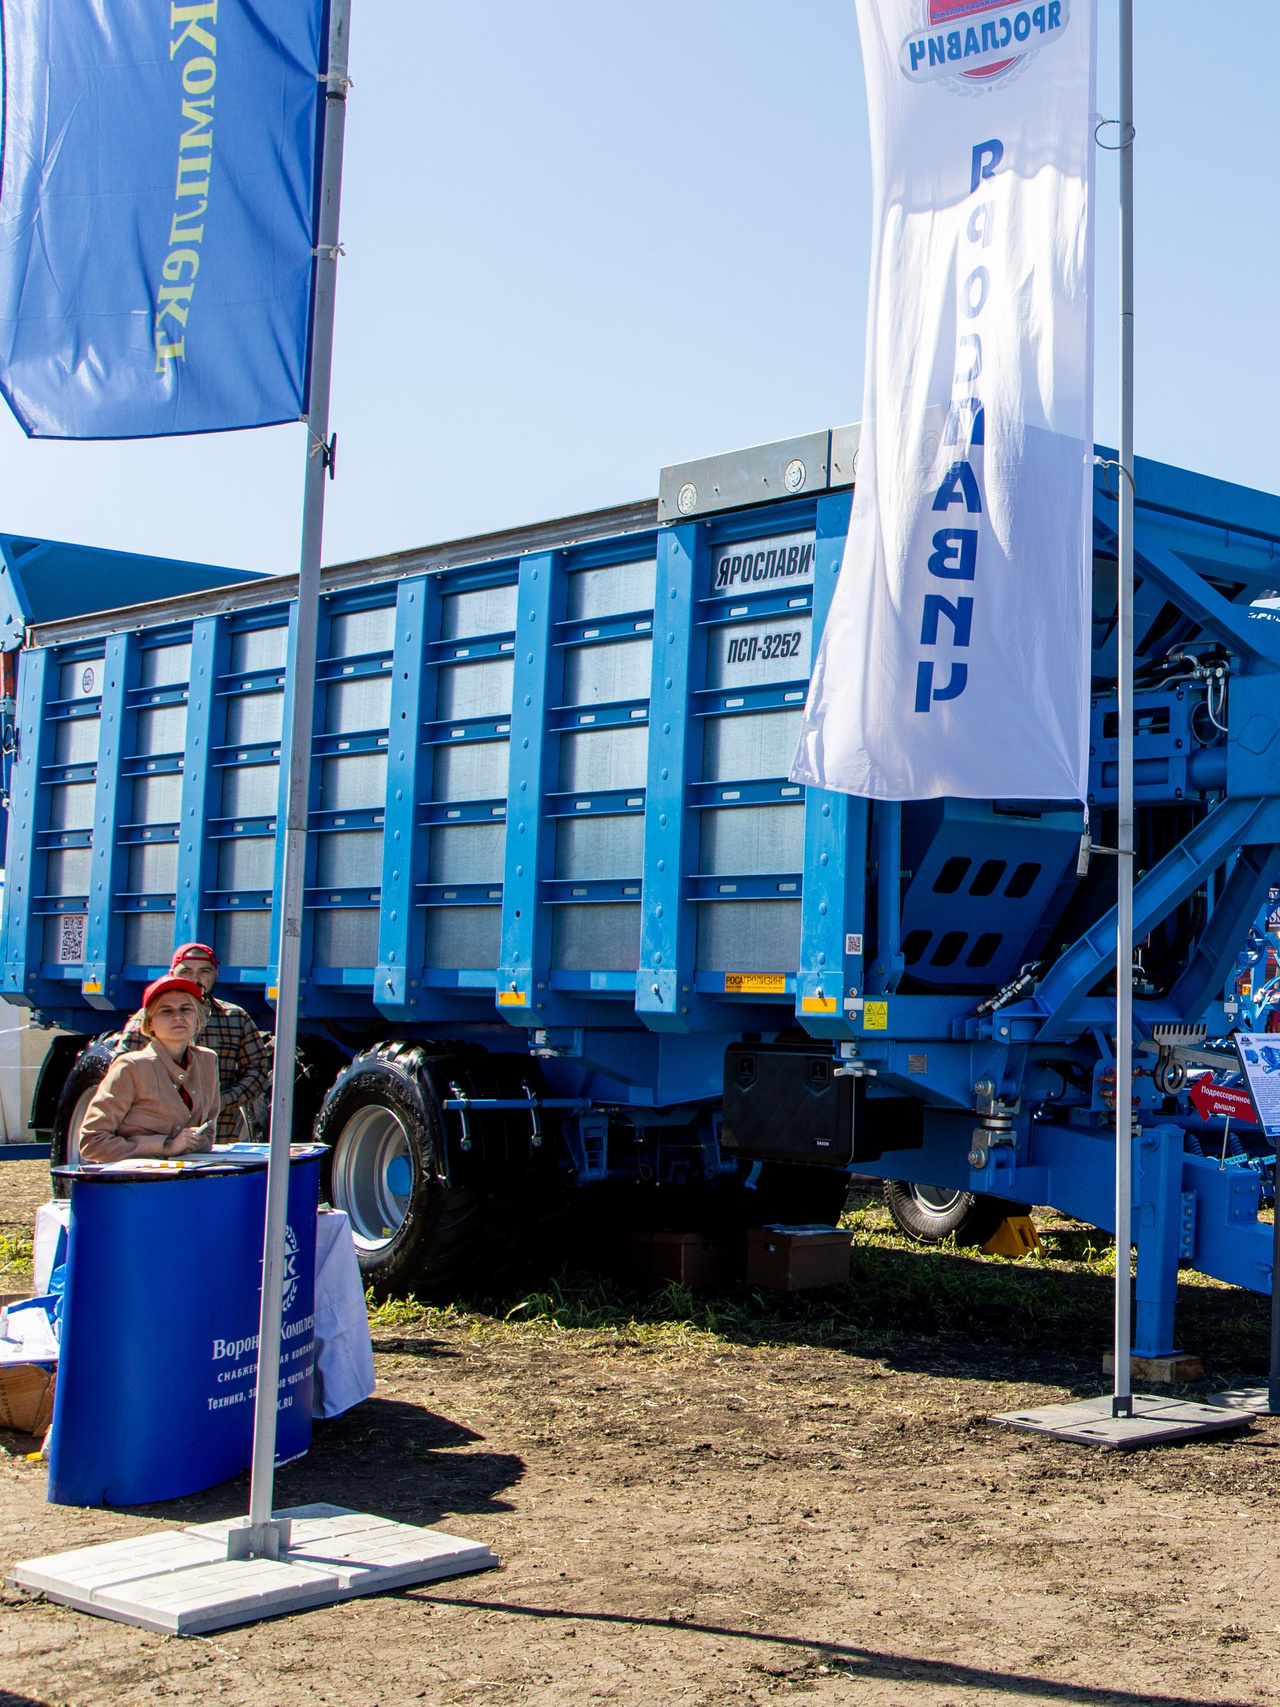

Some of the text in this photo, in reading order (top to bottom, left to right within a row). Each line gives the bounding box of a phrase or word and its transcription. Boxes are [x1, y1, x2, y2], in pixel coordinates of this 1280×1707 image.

[727, 631, 802, 664] ПСП-3252
[725, 975, 785, 986] РОСАГРОЛИЗИНГ
[1201, 1084, 1252, 1106] Подрессоренное
[207, 1390, 247, 1411] Техника,
